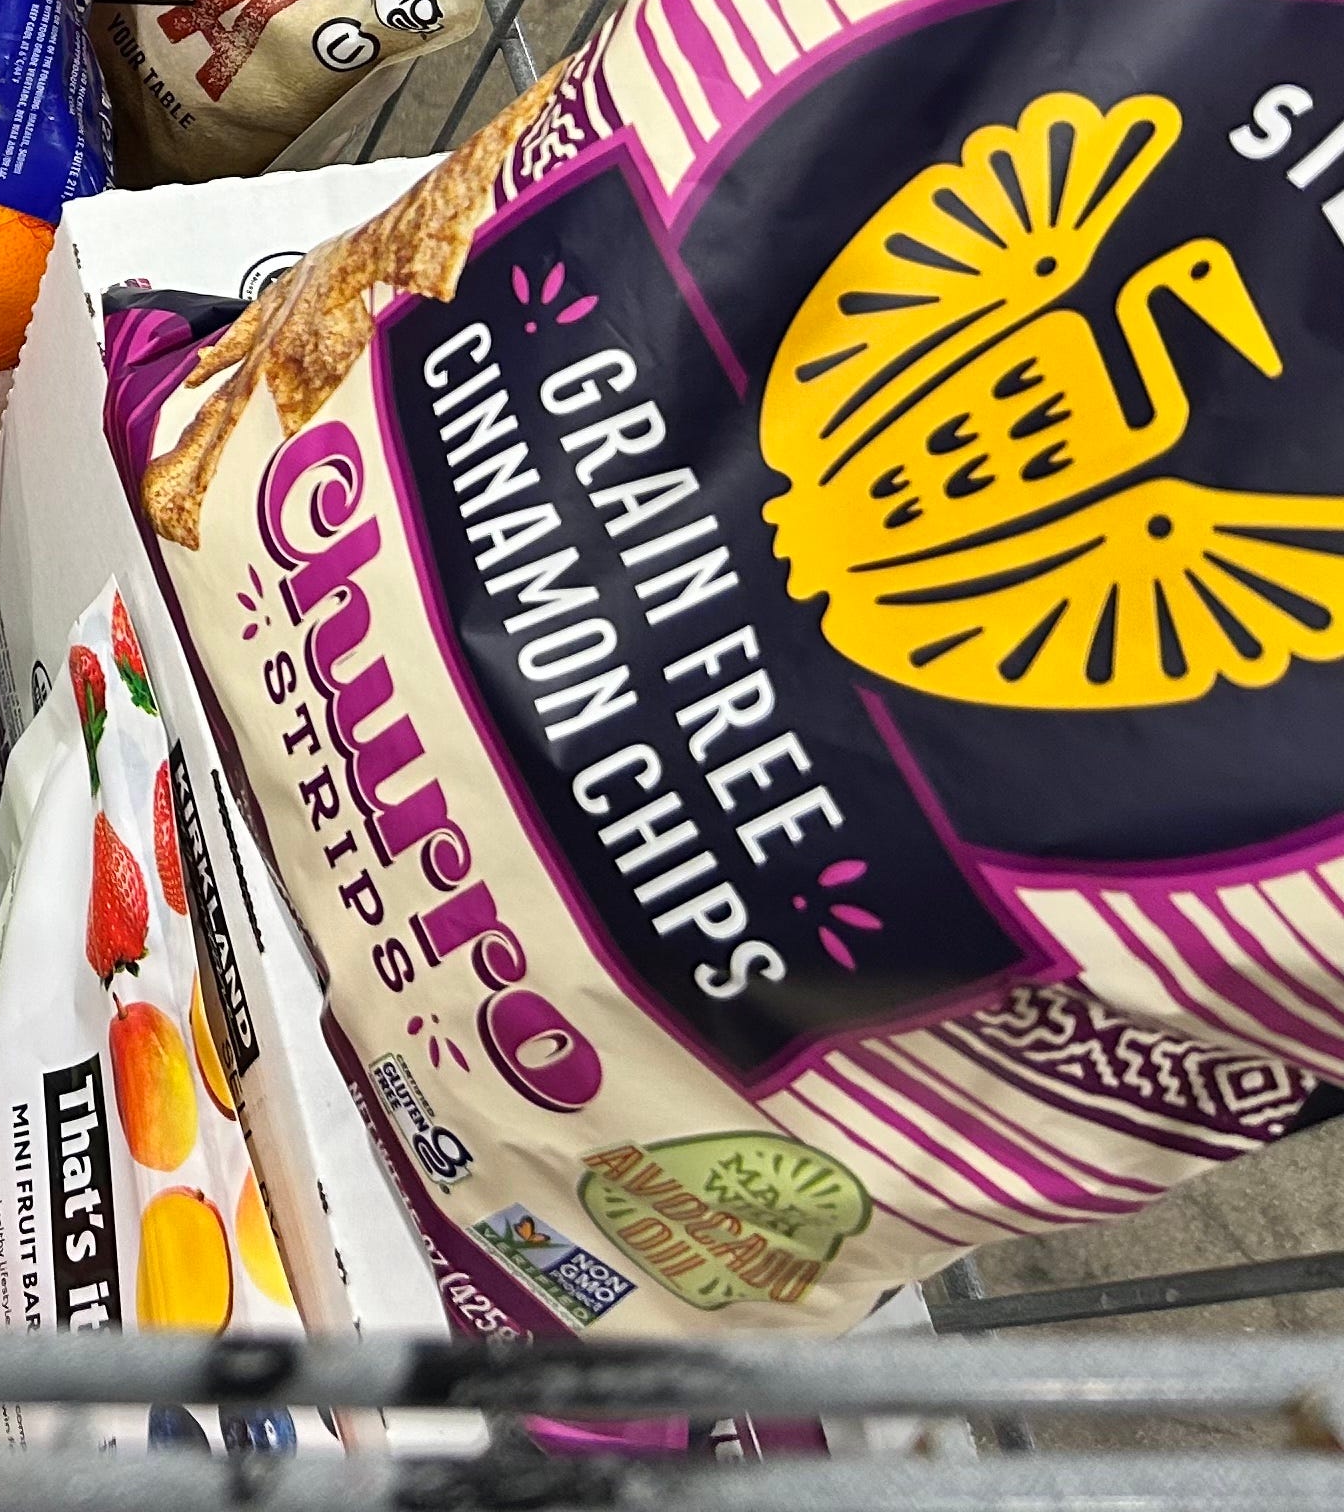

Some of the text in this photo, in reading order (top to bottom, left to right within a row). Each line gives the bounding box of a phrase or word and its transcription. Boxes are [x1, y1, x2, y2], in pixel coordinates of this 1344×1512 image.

[106, 12, 196, 131] YOUR TABLE
[423, 321, 787, 1000] CINNAMON CHIPS
[539, 347, 845, 866] GRAIN FREE
[257, 419, 604, 1113] Churro
[263, 650, 416, 994] STRIPS
[177, 763, 253, 1056] KIRKLAND
[373, 1066, 401, 1112] FREE
[383, 1061, 430, 1133] GLUTEN
[13, 1104, 37, 1265] MINI FRUIT
[58, 1075, 115, 1335] That's it
[580, 1144, 821, 1303] AVOCADO
[616, 1216, 707, 1279] OIL
[560, 1263, 616, 1303] GMO
[572, 1252, 631, 1293] NON
